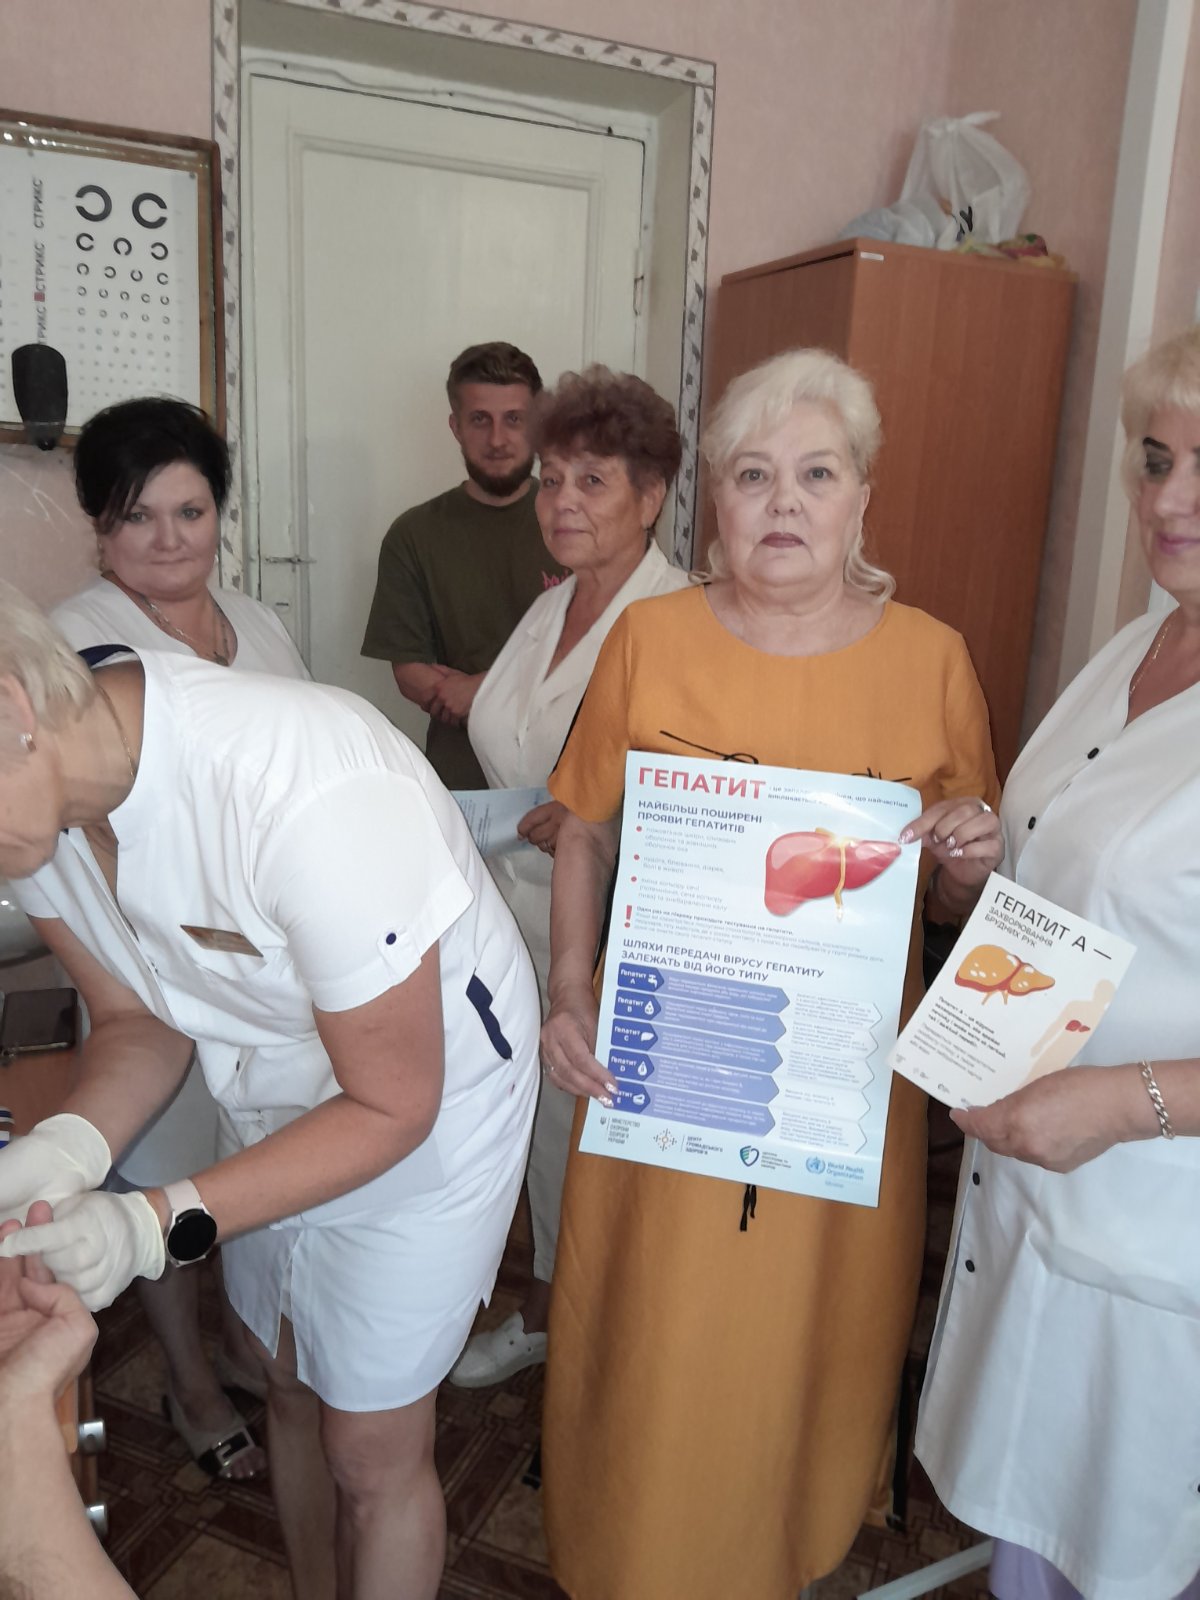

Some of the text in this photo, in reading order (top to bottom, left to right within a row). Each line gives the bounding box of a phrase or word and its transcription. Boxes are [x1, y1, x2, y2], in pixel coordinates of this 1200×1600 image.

[33, 178, 47, 345] ТРИКС СТРИКС СТРИКС
[639, 767, 766, 799] ГЕПАТИТ
[637, 811, 745, 833] ПРОЯВИ ГЕПАТИТІВ
[638, 800, 762, 823] НАЙБІЛЬШ ПОШИРЕНІ
[984, 913, 1037, 948] БРУДНИХ РУК
[989, 906, 1053, 947] ЗАХВОРЮВАННЯ
[995, 891, 1070, 940] ГЕПАТИТ
[1072, 935, 1086, 952] А
[620, 969, 647, 979] Гепатит
[621, 950, 769, 982] ЗАЛЕЖАТЬ ВІД ЙОГО ТИПУ
[623, 938, 824, 978] ШЛЯХИ ПЕРЕДАЧІ ВІРУСУ ГЕПАТИТУ
[617, 996, 644, 1007] Гепатит
[614, 1026, 641, 1036] Гепатит
[611, 1056, 637, 1066] Гепатит
